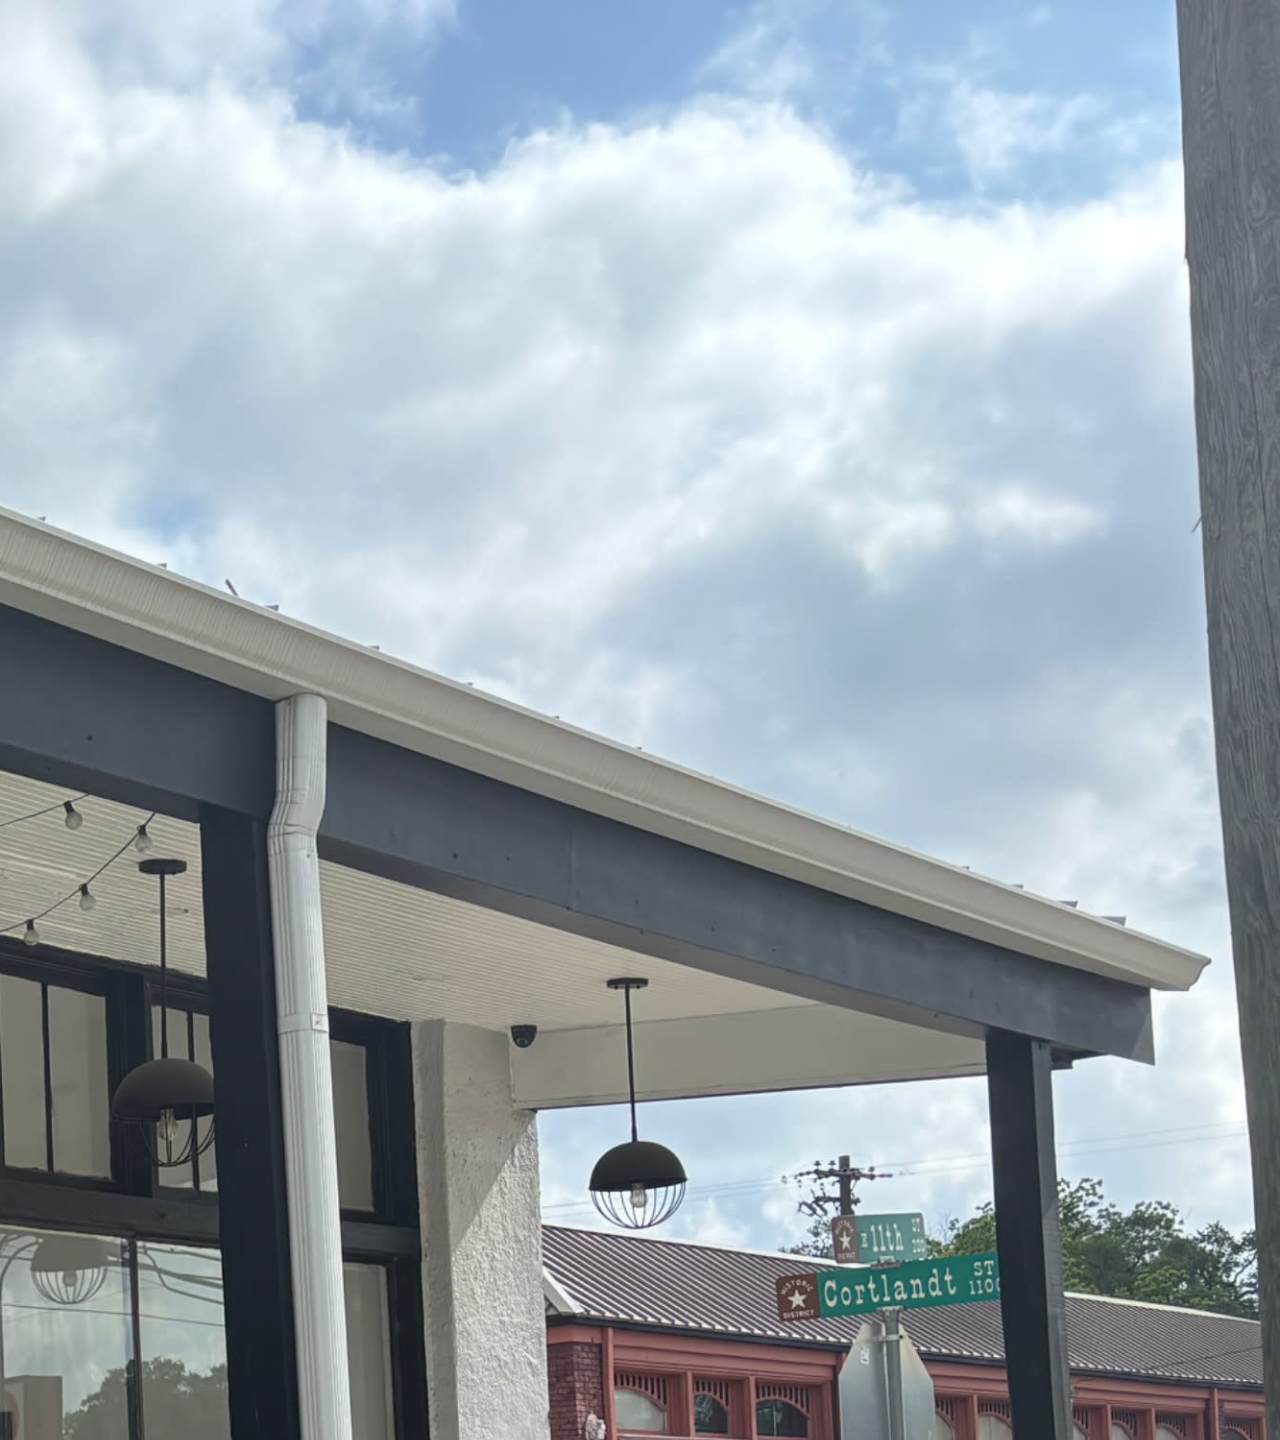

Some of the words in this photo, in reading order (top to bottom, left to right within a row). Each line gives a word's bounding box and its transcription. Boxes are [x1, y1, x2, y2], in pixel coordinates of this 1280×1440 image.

[870, 1223, 904, 1252] 11th
[781, 1278, 815, 1295] HISTORIC
[824, 1267, 957, 1308] Cortlandt
[973, 1260, 995, 1277] ST
[783, 1309, 815, 1320] DISTRICT
